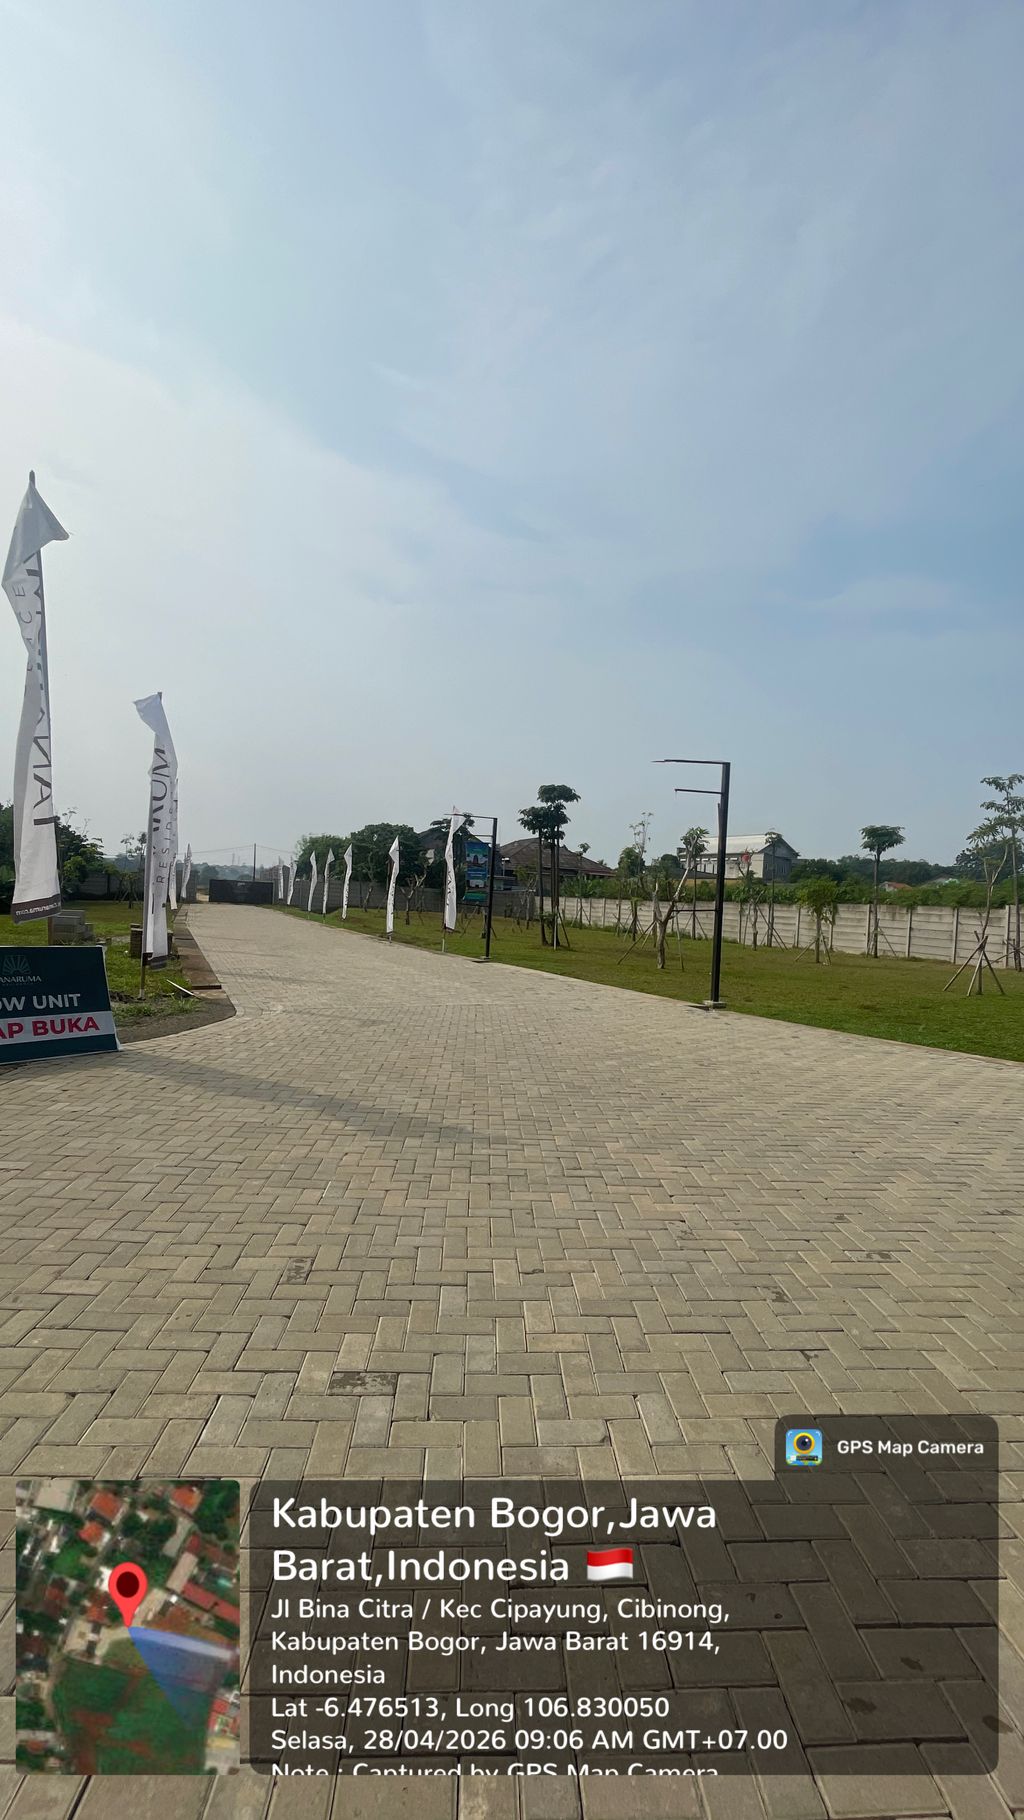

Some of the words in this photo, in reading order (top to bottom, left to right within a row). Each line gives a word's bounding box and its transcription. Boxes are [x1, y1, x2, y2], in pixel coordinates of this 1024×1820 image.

[0, 996, 26, 1011] W
[33, 993, 81, 1010] UNIT
[31, 1016, 100, 1036] BUKA
